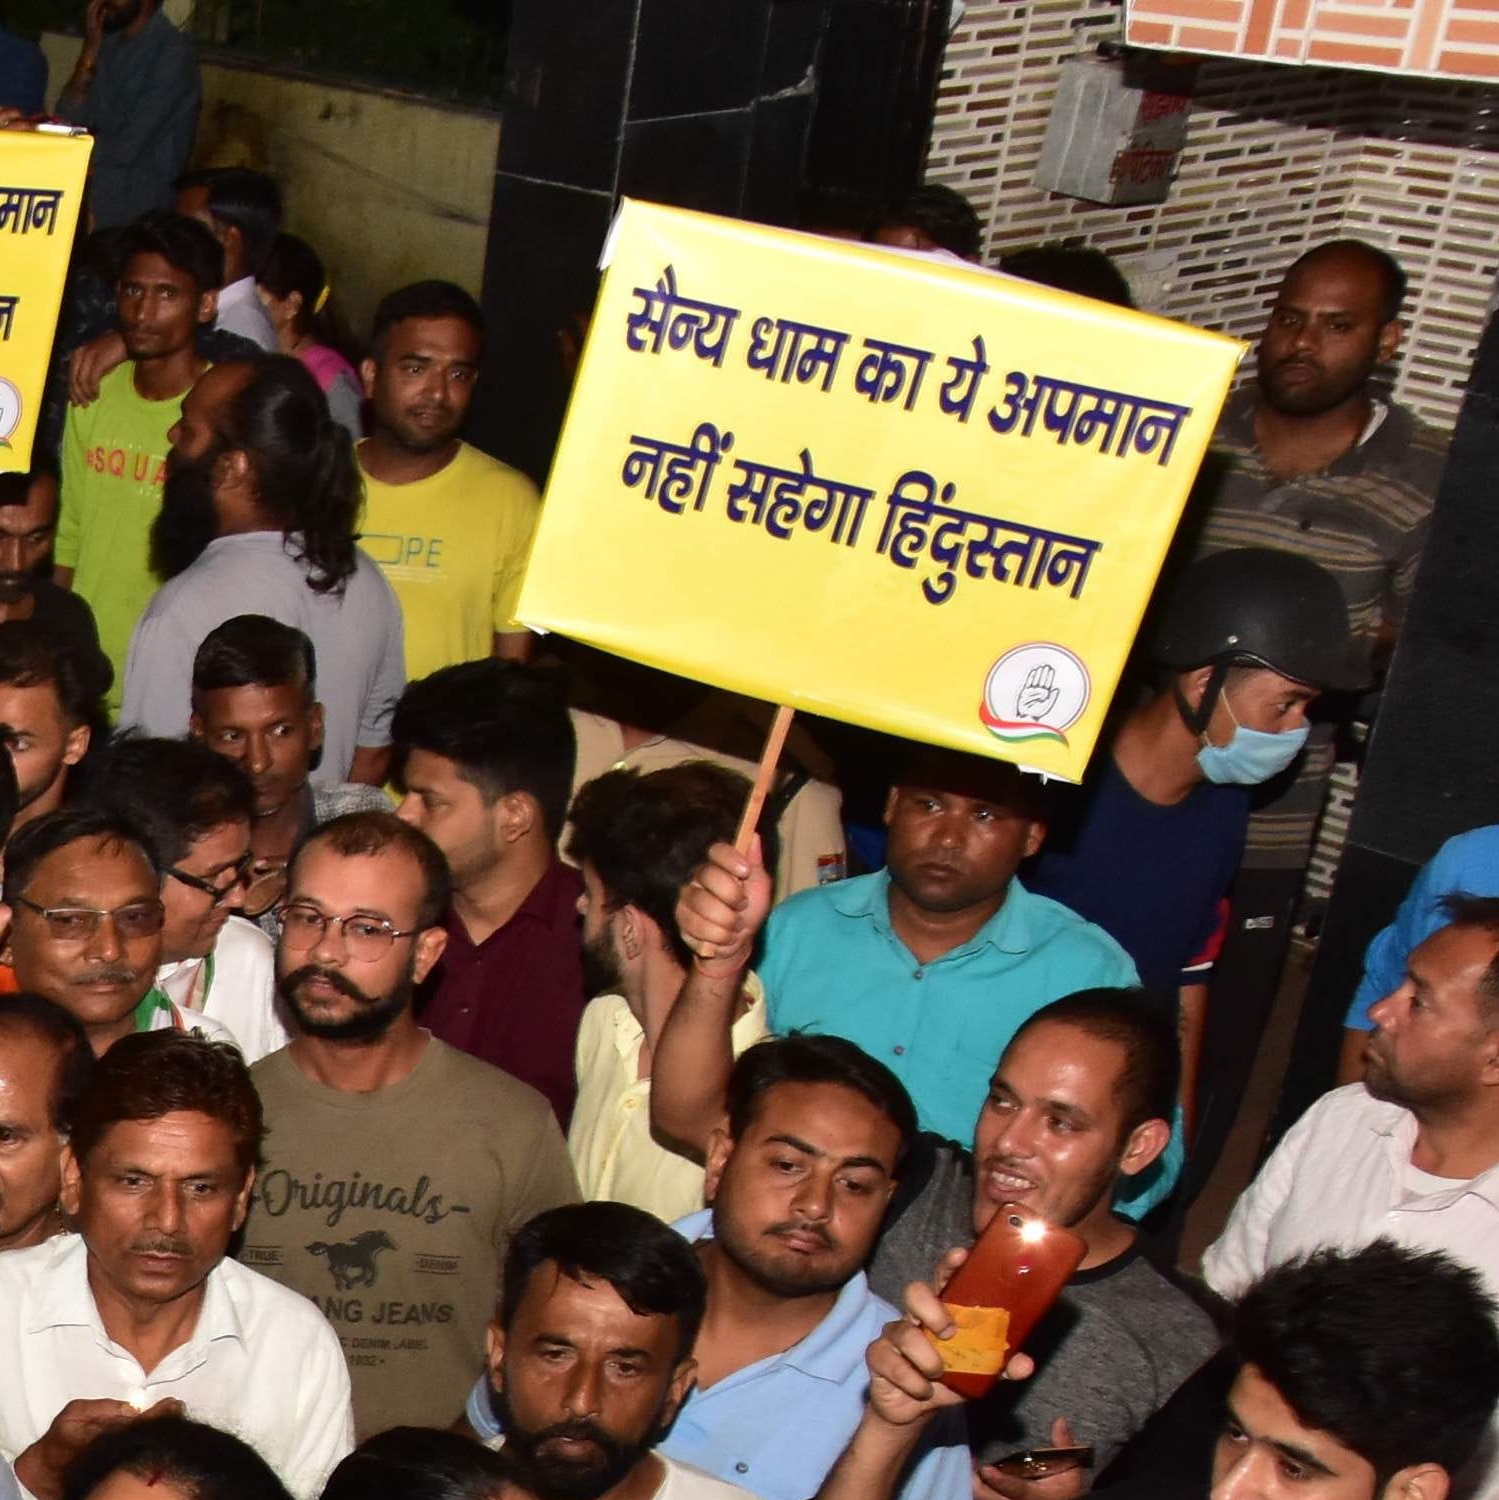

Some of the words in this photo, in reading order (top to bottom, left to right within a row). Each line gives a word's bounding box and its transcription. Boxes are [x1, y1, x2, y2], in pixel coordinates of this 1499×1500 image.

[626, 265, 740, 367] सैन्य
[747, 316, 850, 393] धाम
[854, 338, 935, 411] का
[938, 334, 990, 423] ये
[987, 371, 1193, 466] अपमान
[621, 422, 734, 514] नहीं
[726, 448, 875, 540] सहेगा
[876, 470, 1102, 605] हिंदुस्तान
[371, 1302, 454, 1326] JEANS
